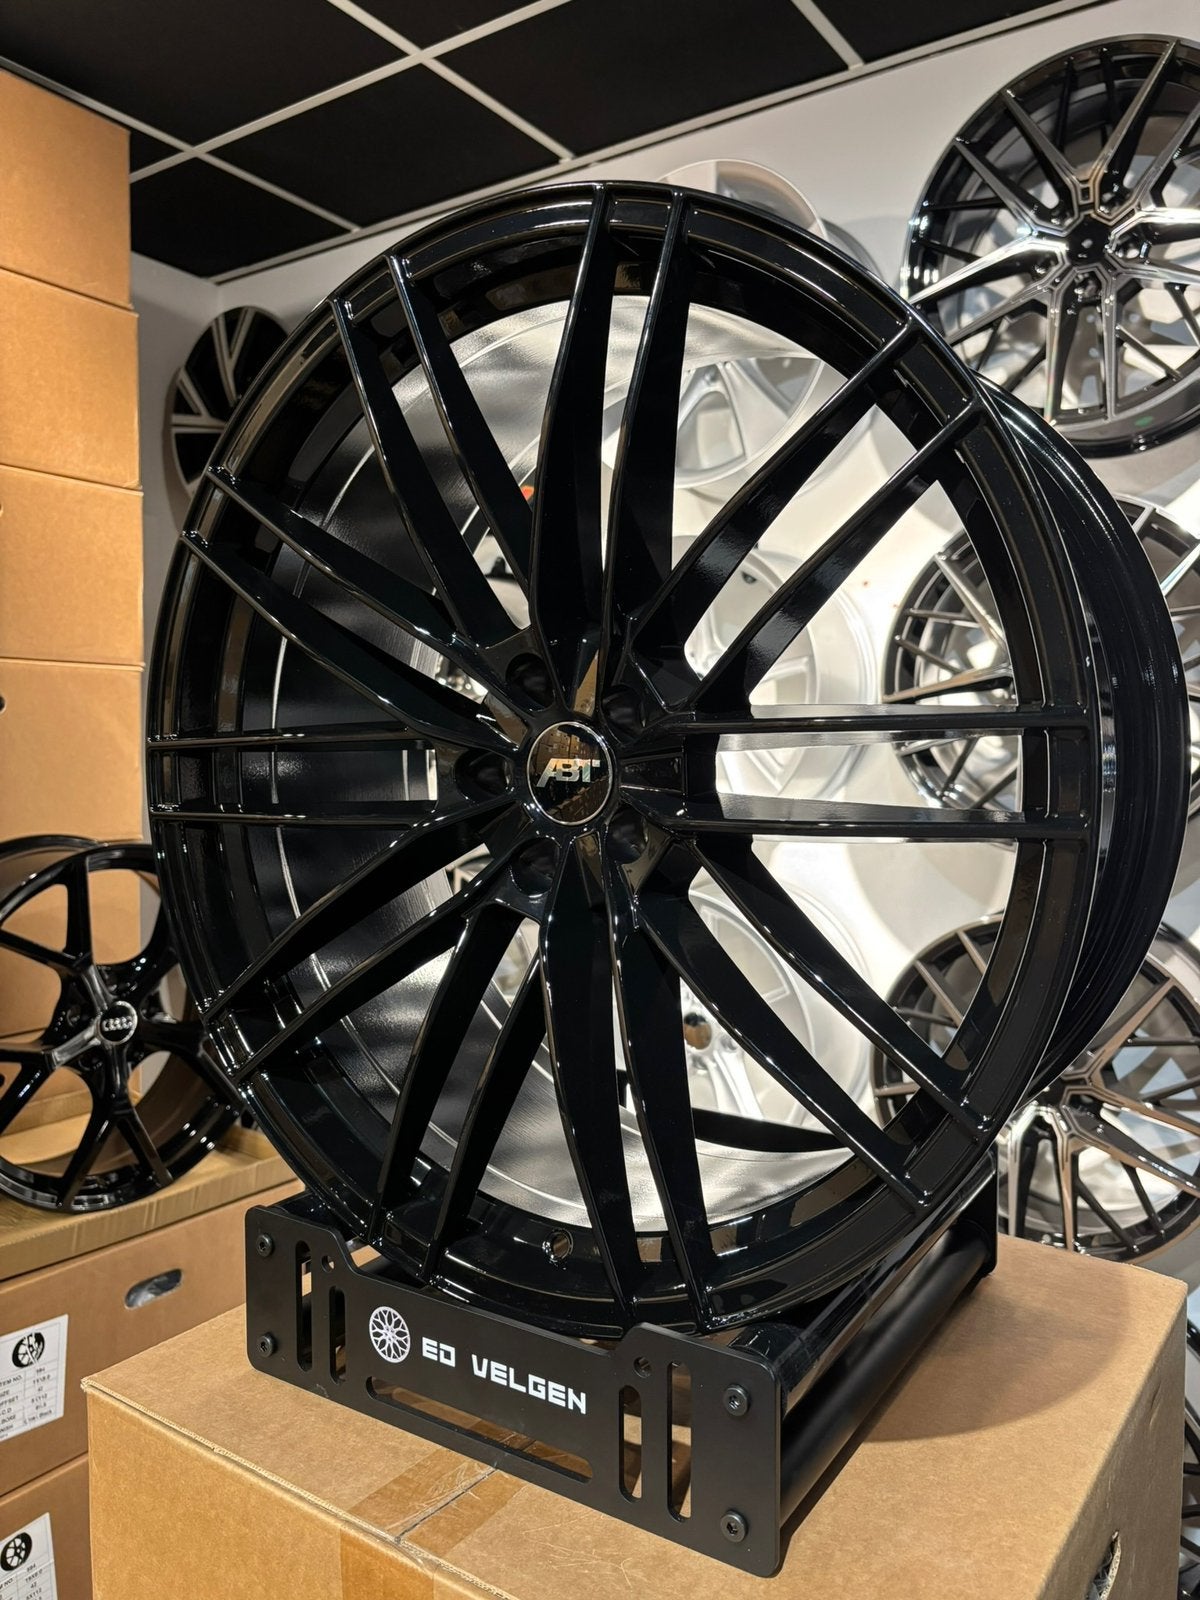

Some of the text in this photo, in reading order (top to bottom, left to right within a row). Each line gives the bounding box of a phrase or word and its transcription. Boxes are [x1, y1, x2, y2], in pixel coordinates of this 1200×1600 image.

[536, 758, 601, 788] ABT
[0, 1378, 12, 1387] TEM
[471, 1353, 587, 1415] VELGEN
[0, 1395, 19, 1406] FFSET
